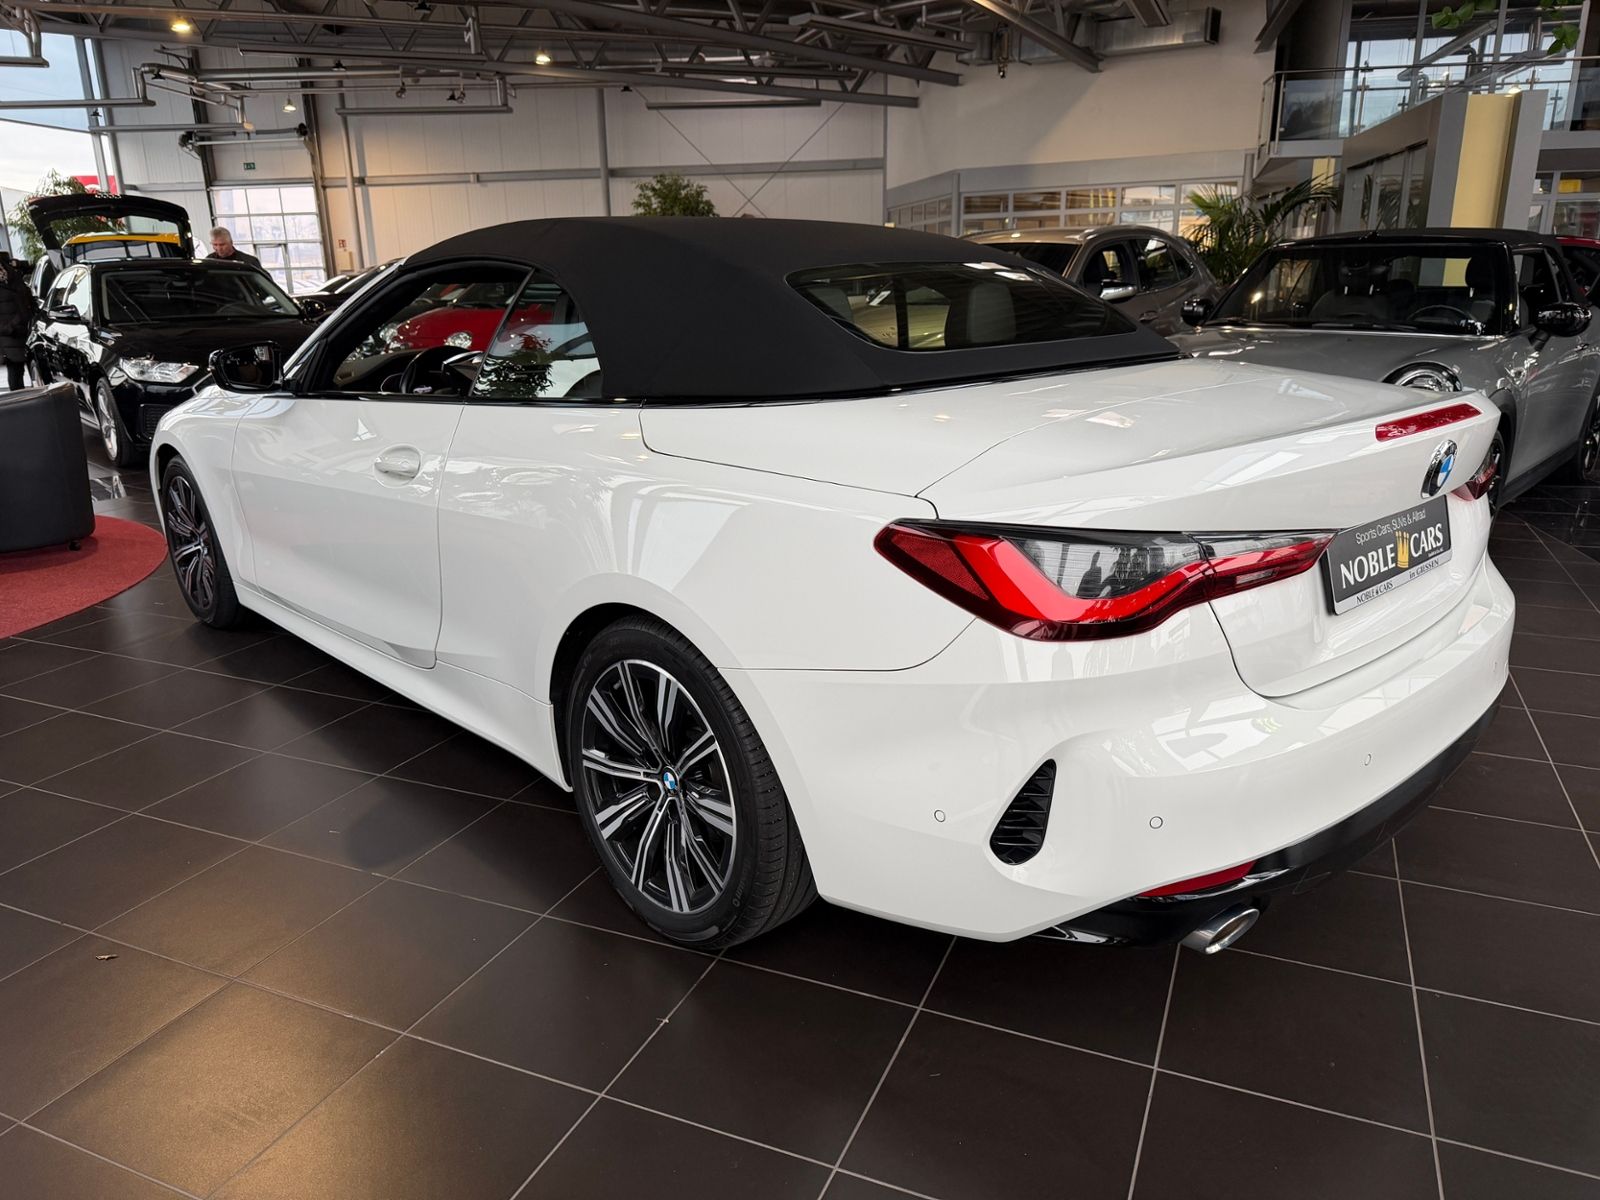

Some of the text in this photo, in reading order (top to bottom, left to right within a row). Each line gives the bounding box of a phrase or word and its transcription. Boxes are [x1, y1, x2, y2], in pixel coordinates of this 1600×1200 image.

[1355, 529, 1377, 545] Sports
[1376, 523, 1394, 538] Cars,
[1406, 513, 1412, 525] &
[1340, 523, 1443, 589] NOBLE CARS
[1355, 588, 1376, 604] NOBLE
[1378, 581, 1394, 594] CARS
[1409, 571, 1416, 580] in
